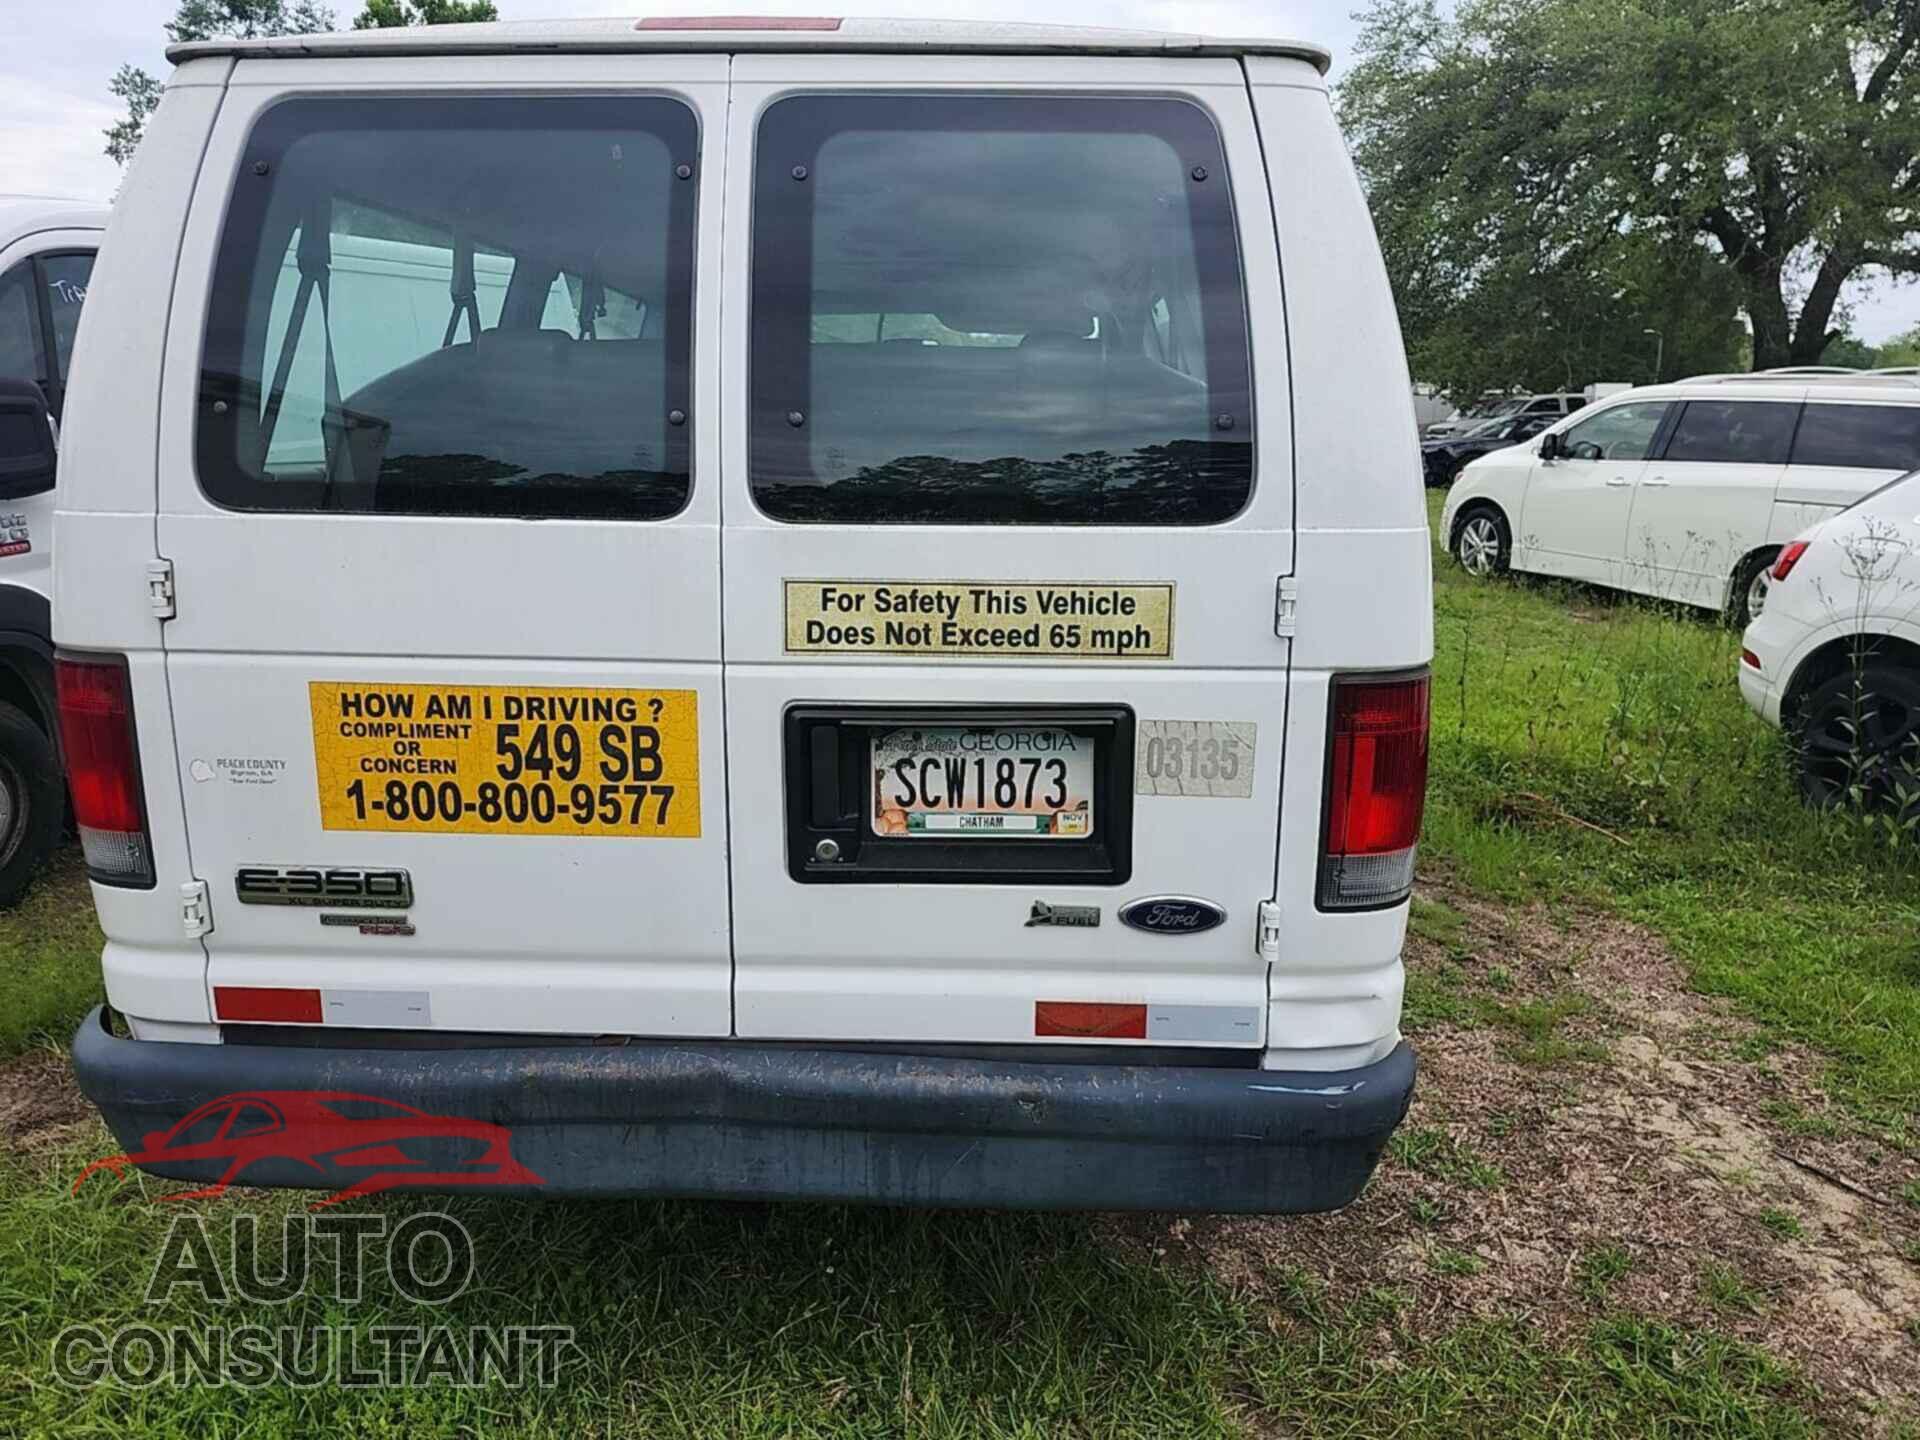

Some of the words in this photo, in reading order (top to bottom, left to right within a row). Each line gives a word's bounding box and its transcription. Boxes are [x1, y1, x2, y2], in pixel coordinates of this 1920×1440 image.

[821, 588, 866, 613] For
[874, 588, 960, 619] Safety
[969, 590, 1027, 615] This
[1036, 591, 1137, 616] Vehicle
[806, 621, 875, 645] Does
[885, 622, 932, 646] Not
[941, 623, 1040, 647] Exceed
[1049, 625, 1081, 648] 65
[1091, 625, 1151, 655] mph
[340, 693, 414, 719] HOW
[424, 695, 472, 720] AM
[484, 696, 492, 720] I
[504, 697, 637, 722] DRIVING
[339, 722, 472, 739] COMPLIMENT
[959, 731, 1077, 751] GEORGIA
[393, 741, 421, 756] OR
[496, 724, 582, 781] 549
[599, 725, 663, 782] SB
[1146, 737, 1239, 781] 03135
[246, 759, 286, 769] COUNTY
[360, 758, 457, 774] CONCERN
[894, 757, 1067, 809] SCW1873
[346, 780, 675, 825] 1-800-800-9577
[959, 816, 1005, 828] CHATHAM
[1145, 904, 1200, 926] Ford
